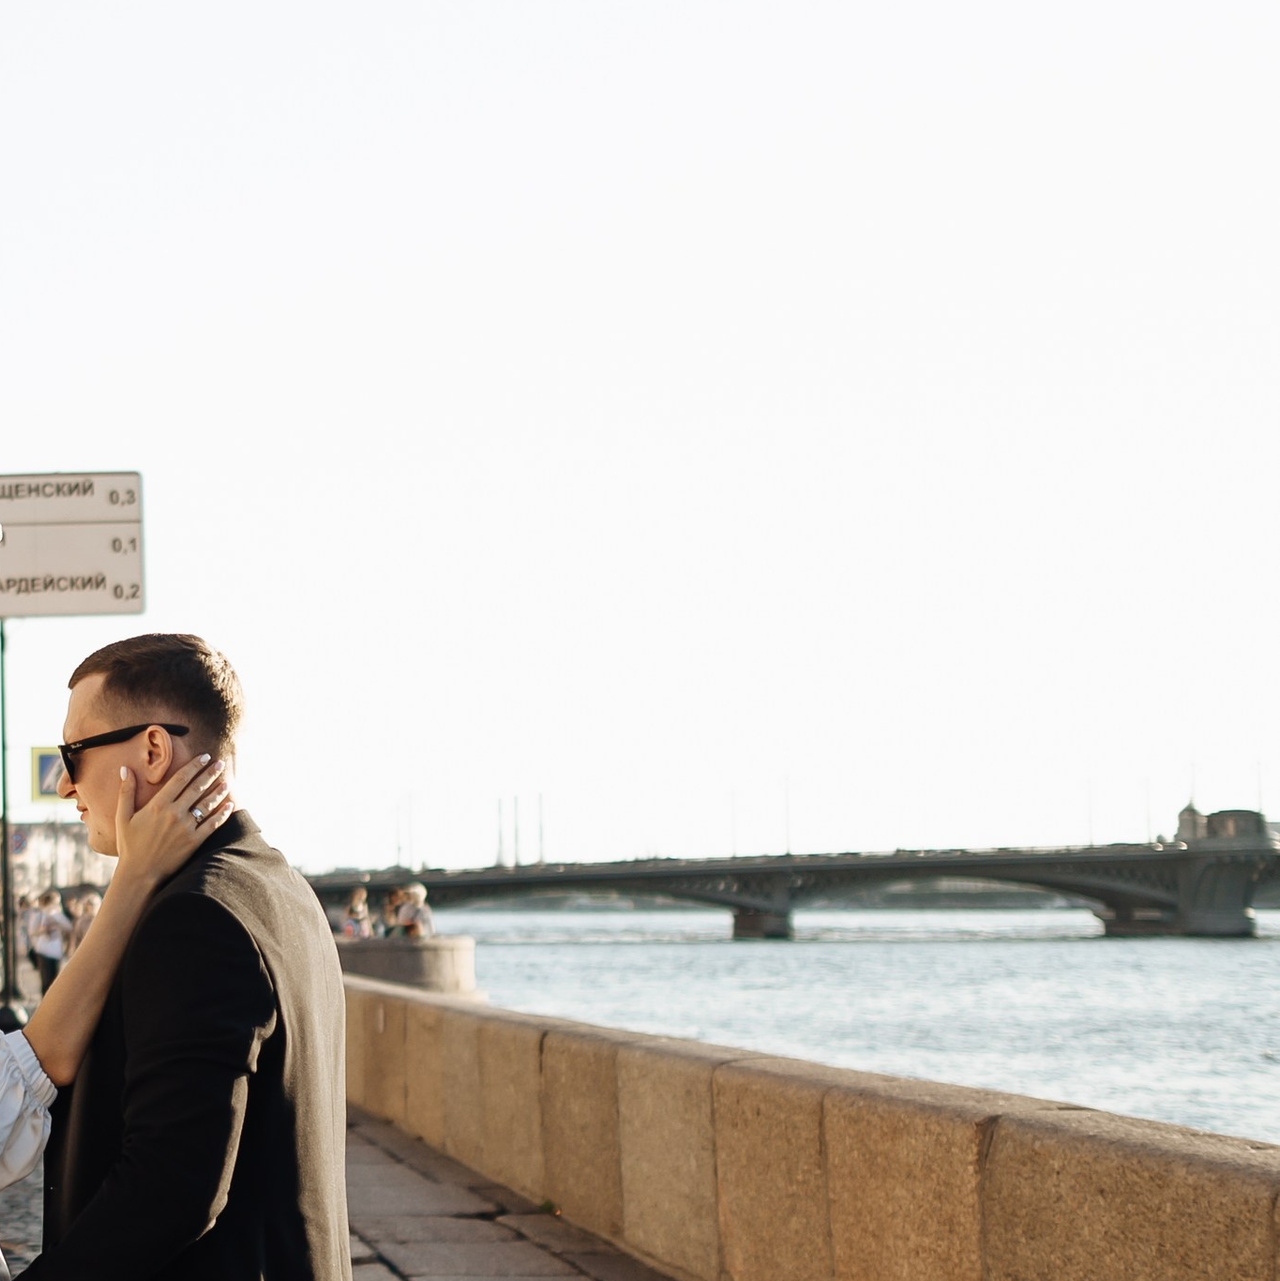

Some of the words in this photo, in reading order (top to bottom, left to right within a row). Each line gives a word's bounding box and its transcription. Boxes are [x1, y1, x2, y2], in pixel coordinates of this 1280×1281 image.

[108, 489, 136, 506] 0,3
[111, 538, 137, 555] 0,1
[113, 583, 140, 601] 0,2
